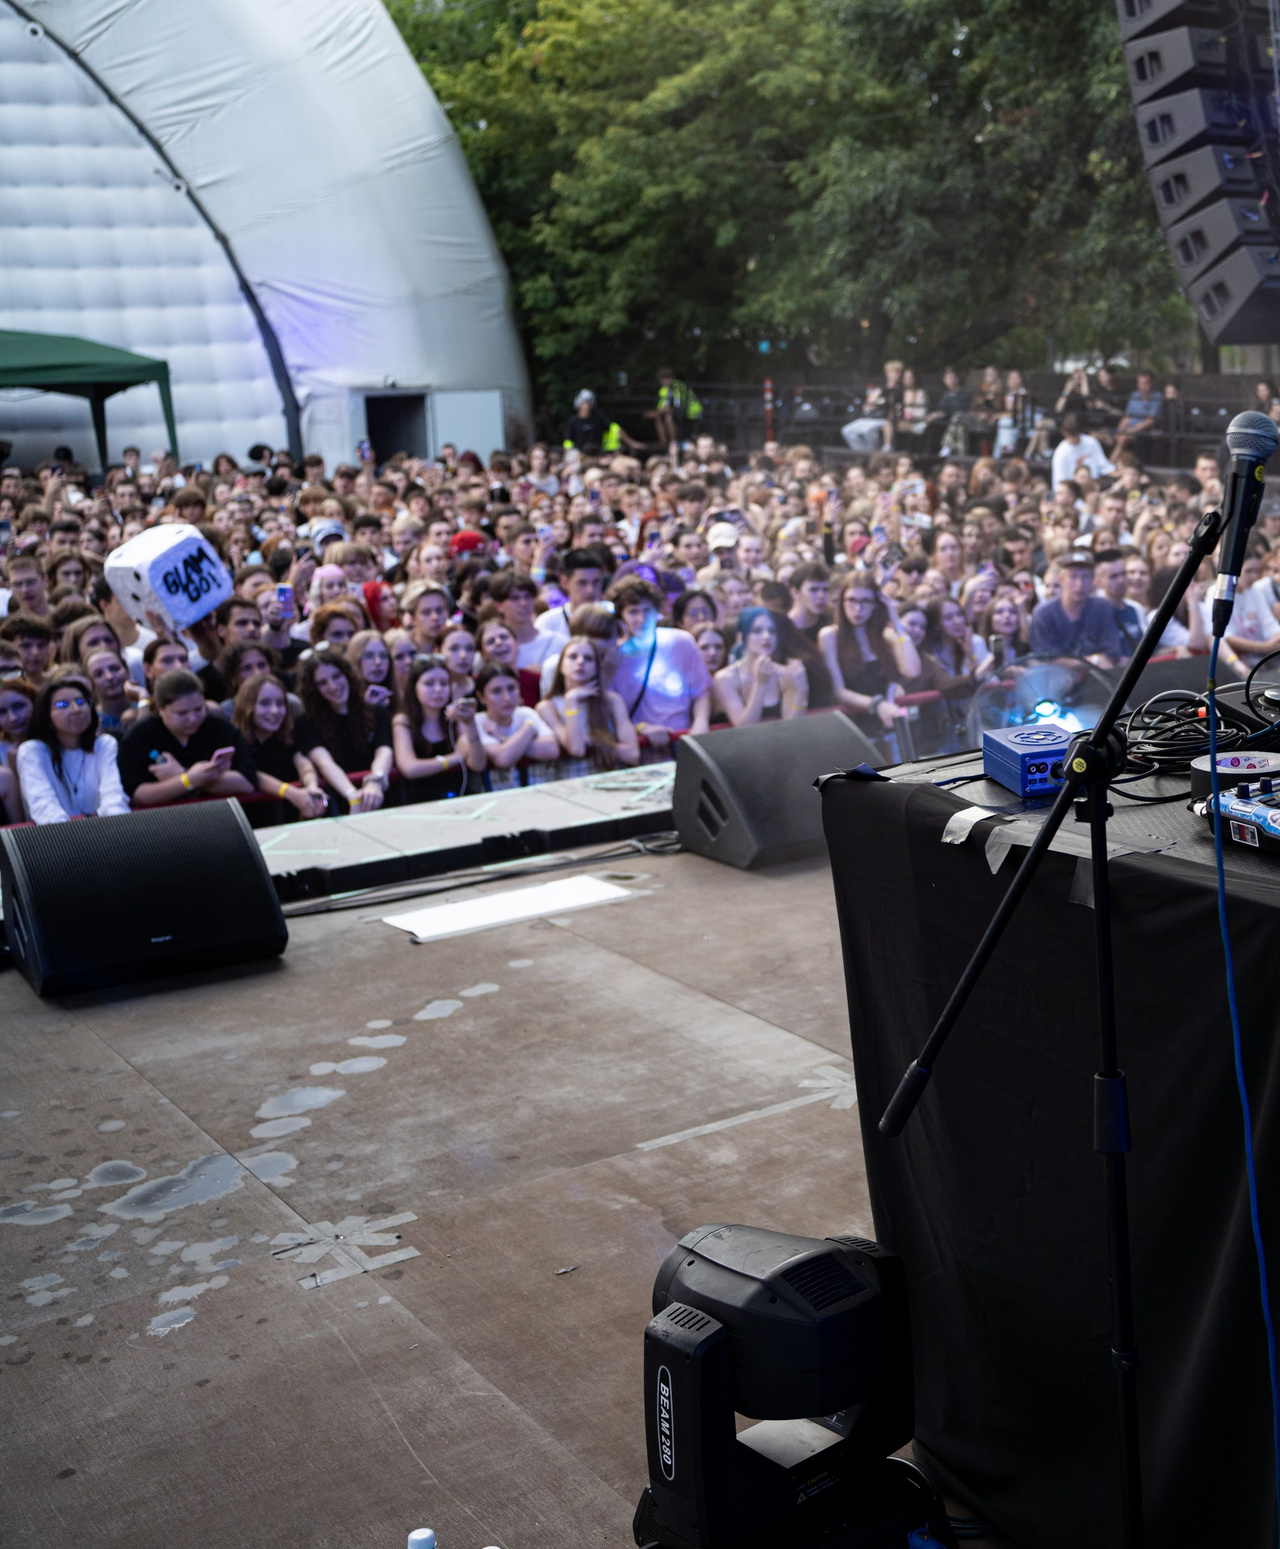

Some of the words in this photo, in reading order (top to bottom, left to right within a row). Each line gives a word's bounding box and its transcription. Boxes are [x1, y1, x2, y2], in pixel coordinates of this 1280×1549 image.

[163, 546, 217, 595] GLAM
[186, 571, 222, 603] GO!
[660, 1382, 670, 1436] BEAM
[661, 1434, 672, 1465] 280
